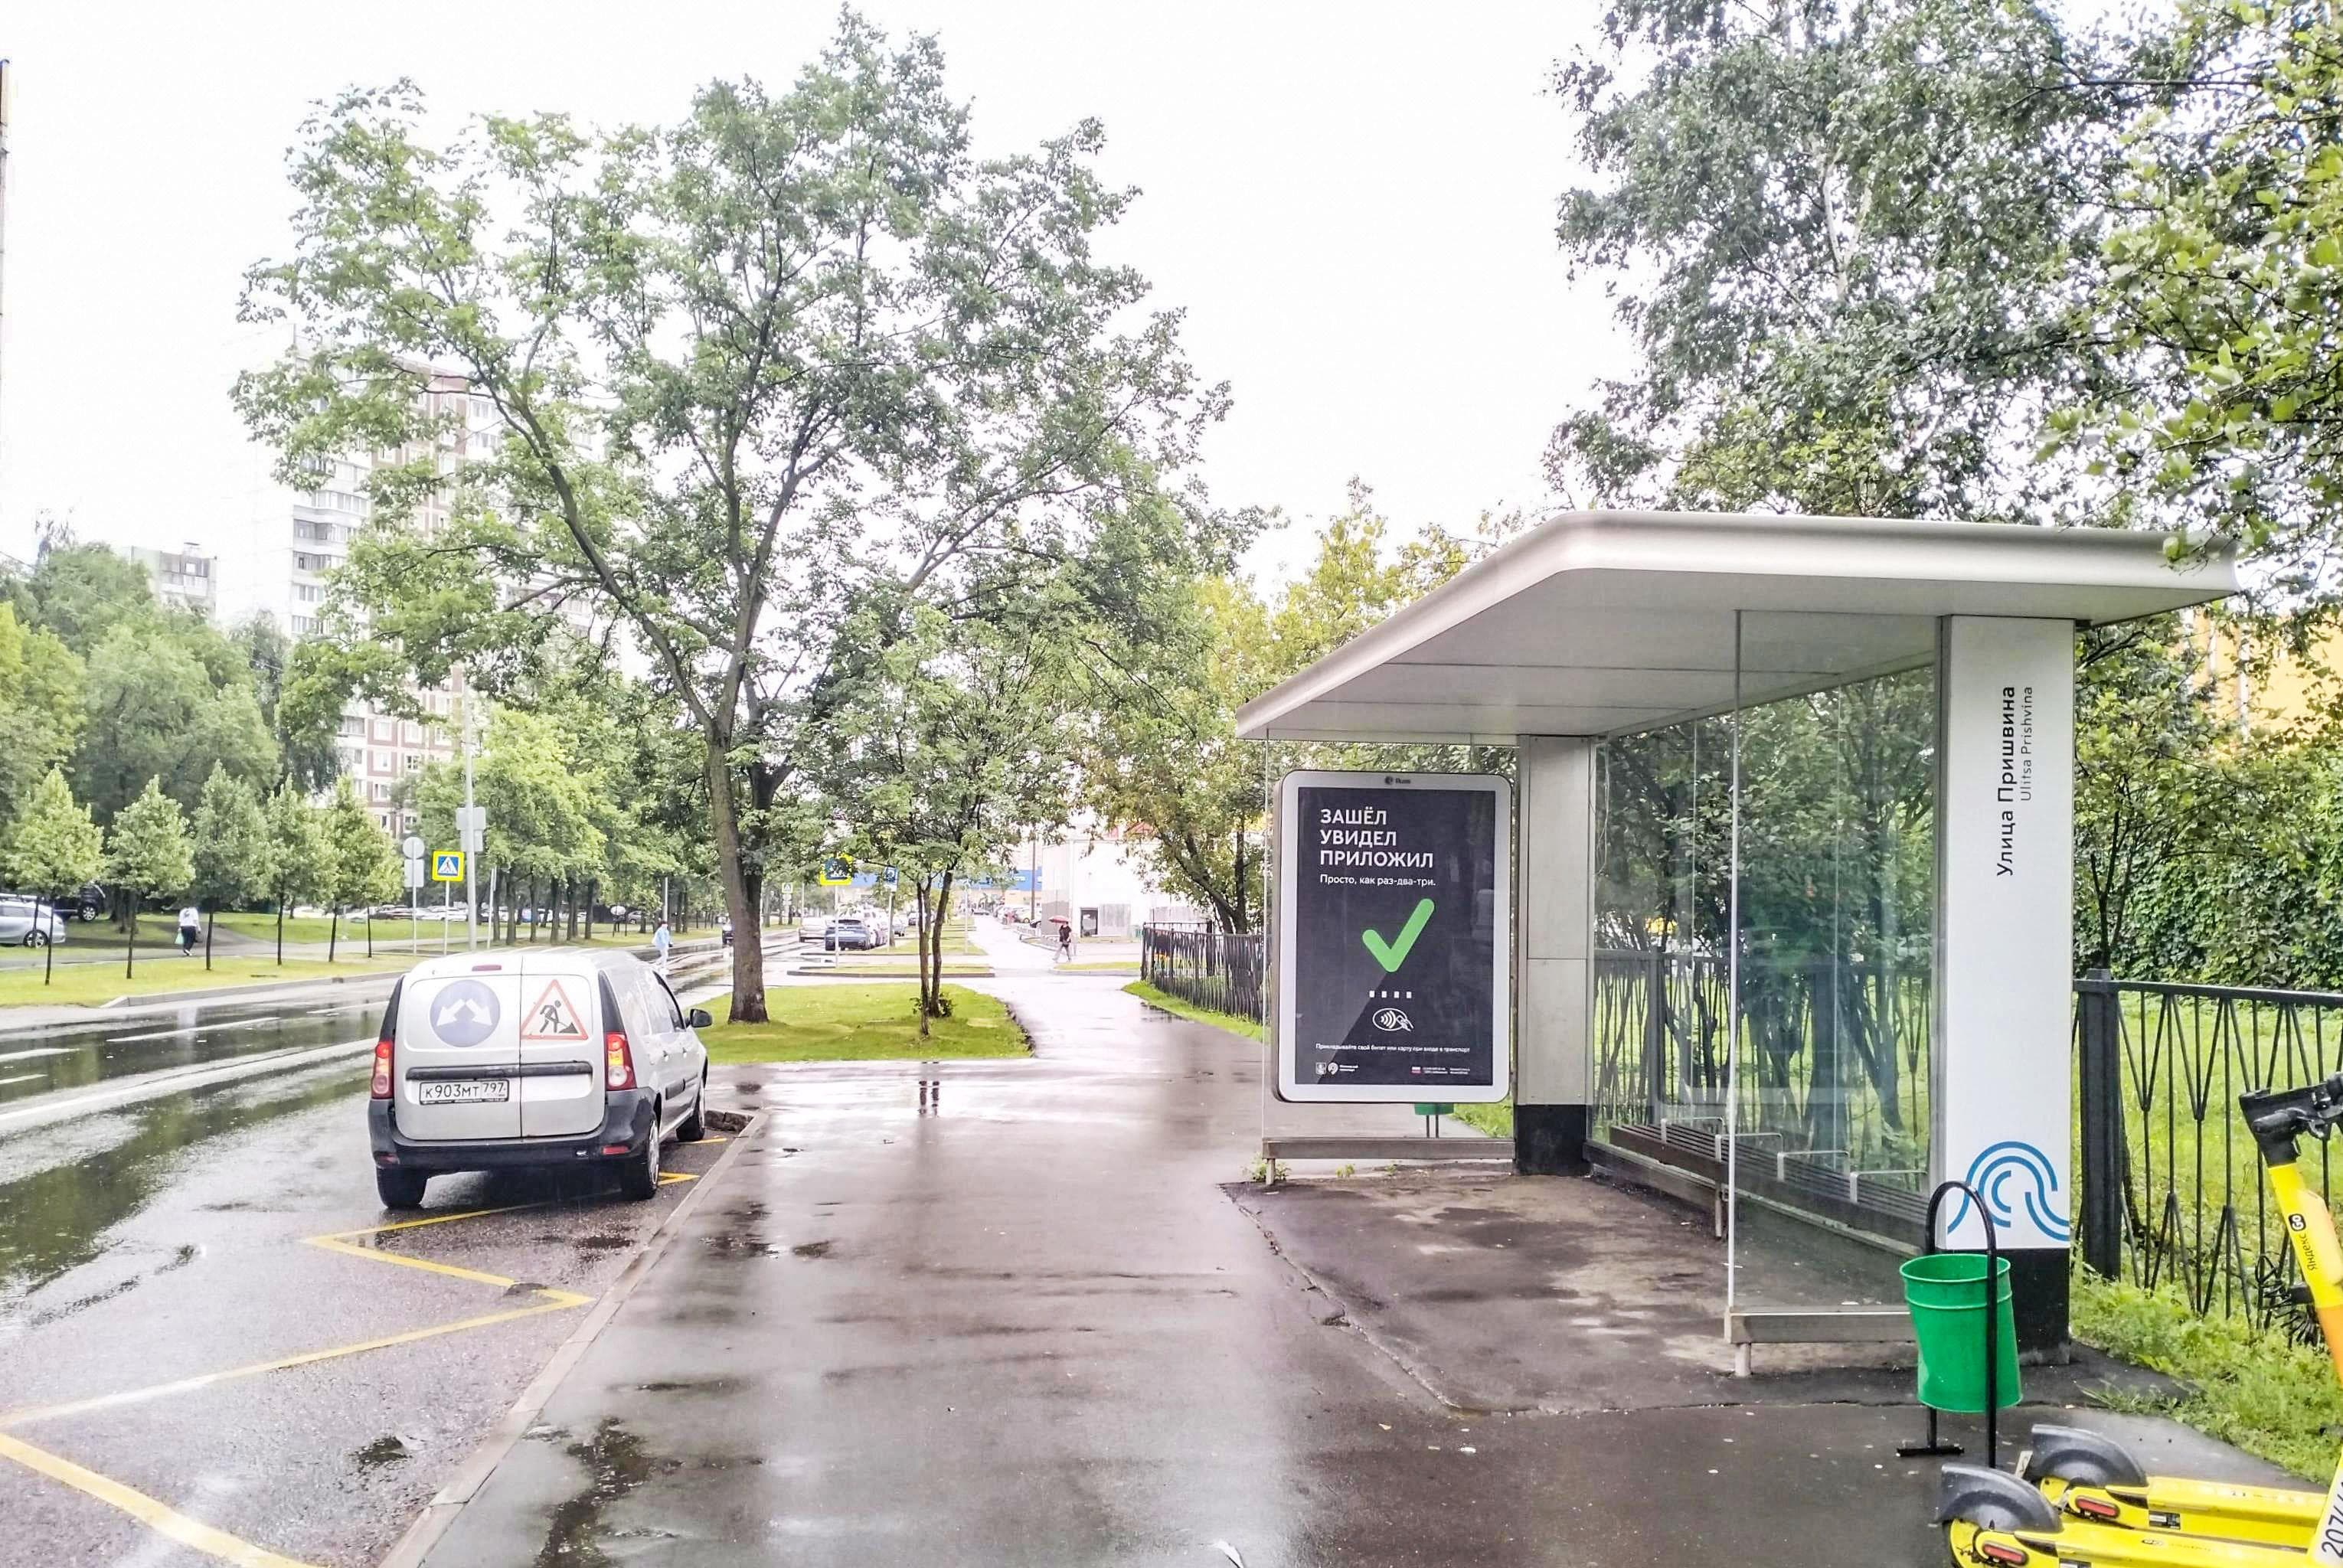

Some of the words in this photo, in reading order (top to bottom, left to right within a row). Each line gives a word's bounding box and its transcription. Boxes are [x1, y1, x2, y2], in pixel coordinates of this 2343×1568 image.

[2021, 686, 2033, 754] Prishvina
[1997, 686, 2017, 803] Пришвина
[2019, 759, 2031, 802] Ulitsa
[1320, 806, 1387, 825] ЗАШЁЛ
[1319, 829, 1397, 848] УВИДЕЛ
[1996, 810, 2016, 877] Улица
[1320, 850, 1433, 868] ПРИЛОЖИЛ
[1320, 874, 1357, 885] Просто,
[1359, 876, 1375, 885] как
[1377, 877, 1436, 887] раз-два-три.
[2299, 1233, 2317, 1271] Яндекс
